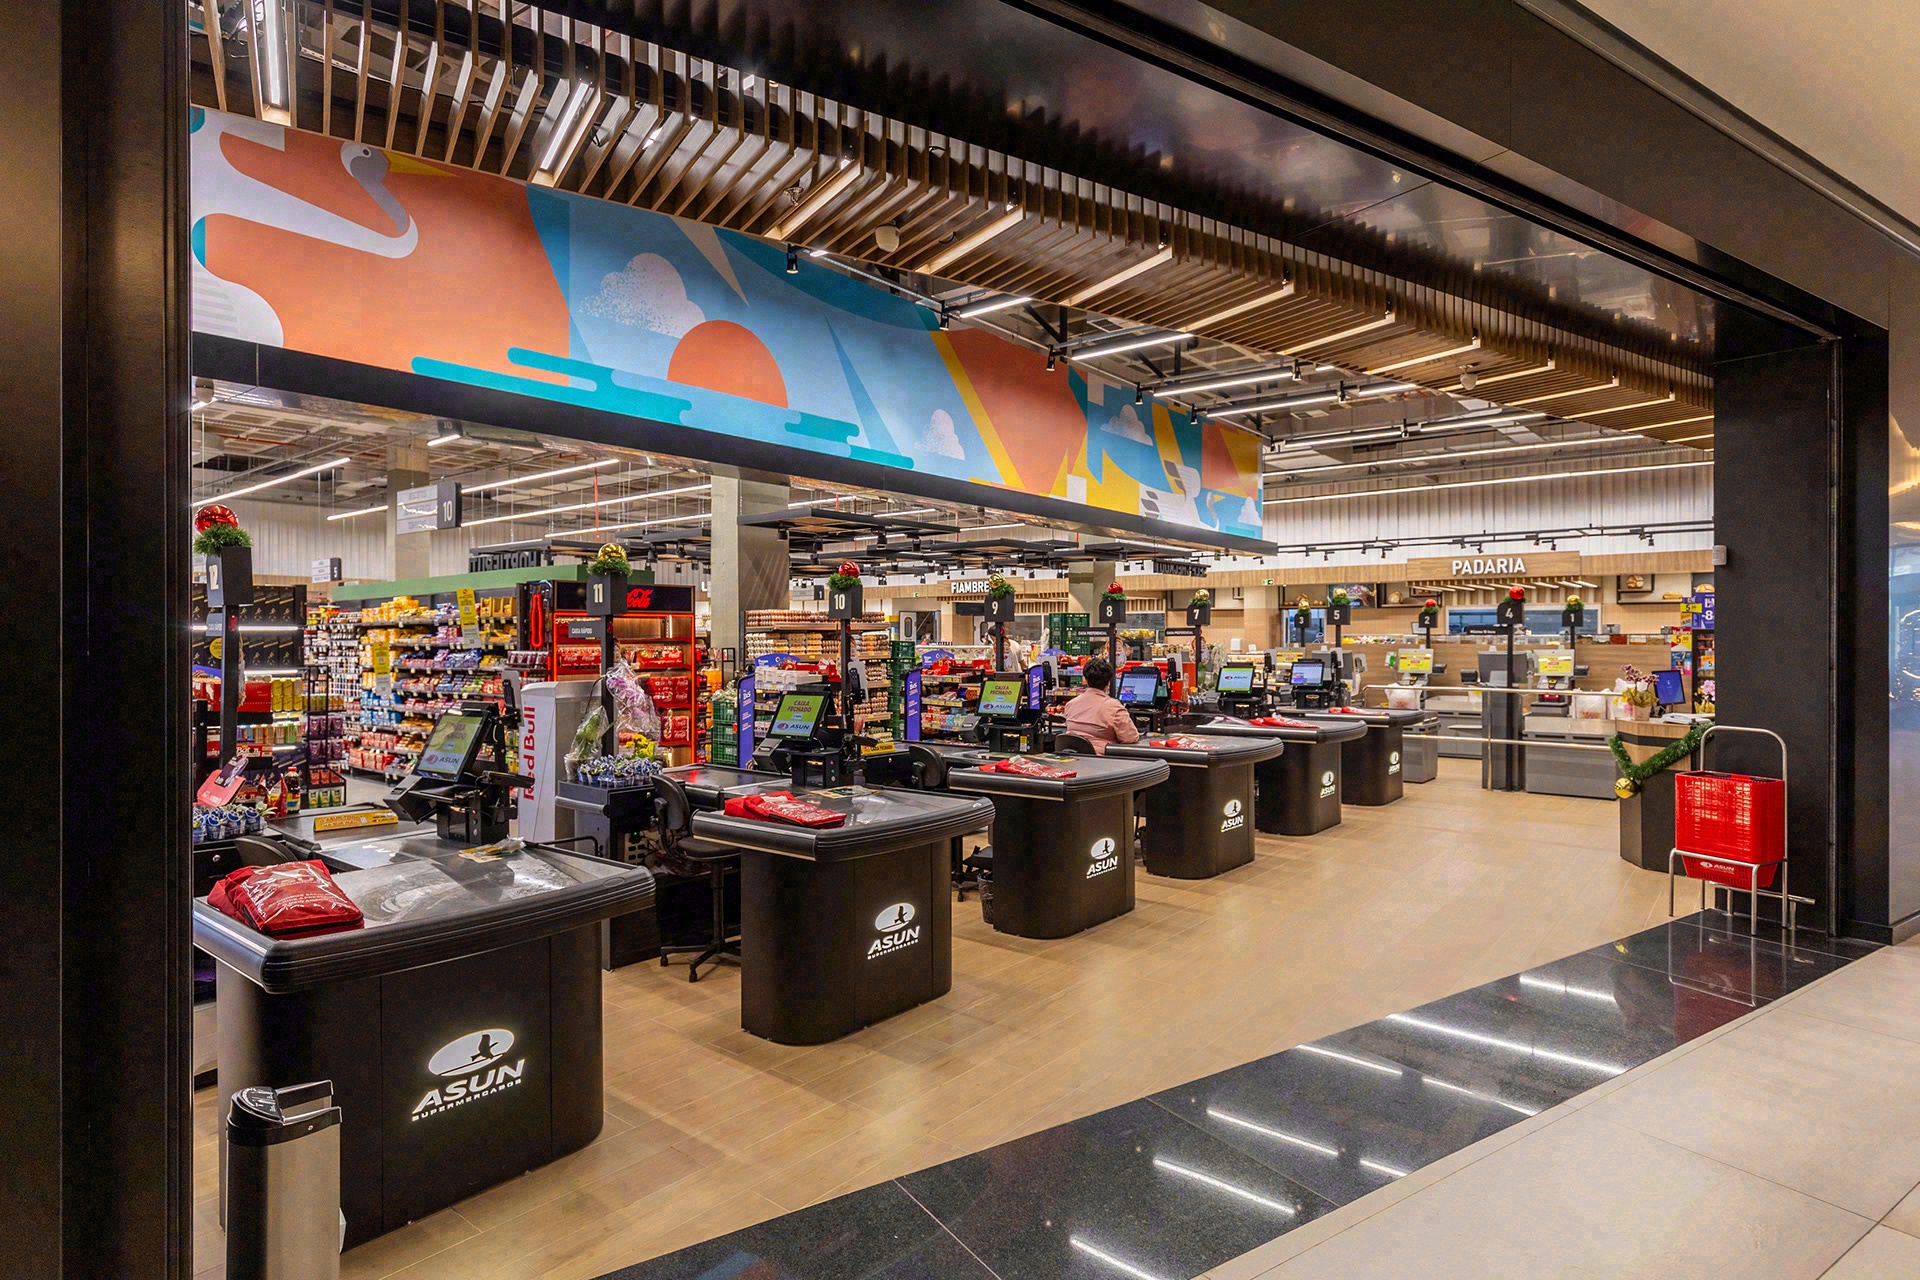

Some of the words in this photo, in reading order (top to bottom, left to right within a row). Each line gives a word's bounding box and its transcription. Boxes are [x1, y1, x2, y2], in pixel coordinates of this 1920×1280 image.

[442, 500, 454, 522] 10
[333, 566, 338, 578] 5
[1452, 557, 1526, 576] PADARIA
[593, 583, 604, 604] 11
[951, 580, 991, 594] FIAMBRE
[818, 590, 824, 599] 1
[833, 593, 847, 611] 10
[991, 600, 999, 615] 9
[1106, 605, 1114, 617] 8
[1193, 608, 1200, 620] 7
[1333, 609, 1340, 620] 5
[1505, 607, 1514, 619] 4
[1298, 616, 1304, 625] 3
[1424, 615, 1431, 625] 2
[1569, 613, 1575, 623] 1
[1676, 635, 1681, 644] 5
[523, 706, 536, 751] Bull
[440, 756, 460, 764] ASUN
[1320, 784, 1336, 797] ASUN
[1221, 814, 1244, 830] ASUN
[1087, 855, 1118, 876] ASUN
[1713, 863, 1735, 872] ASUN
[867, 925, 921, 956] ASUN
[411, 1058, 526, 1115] ASUN
[411, 1077, 523, 1123] SUPERMERCADOS
